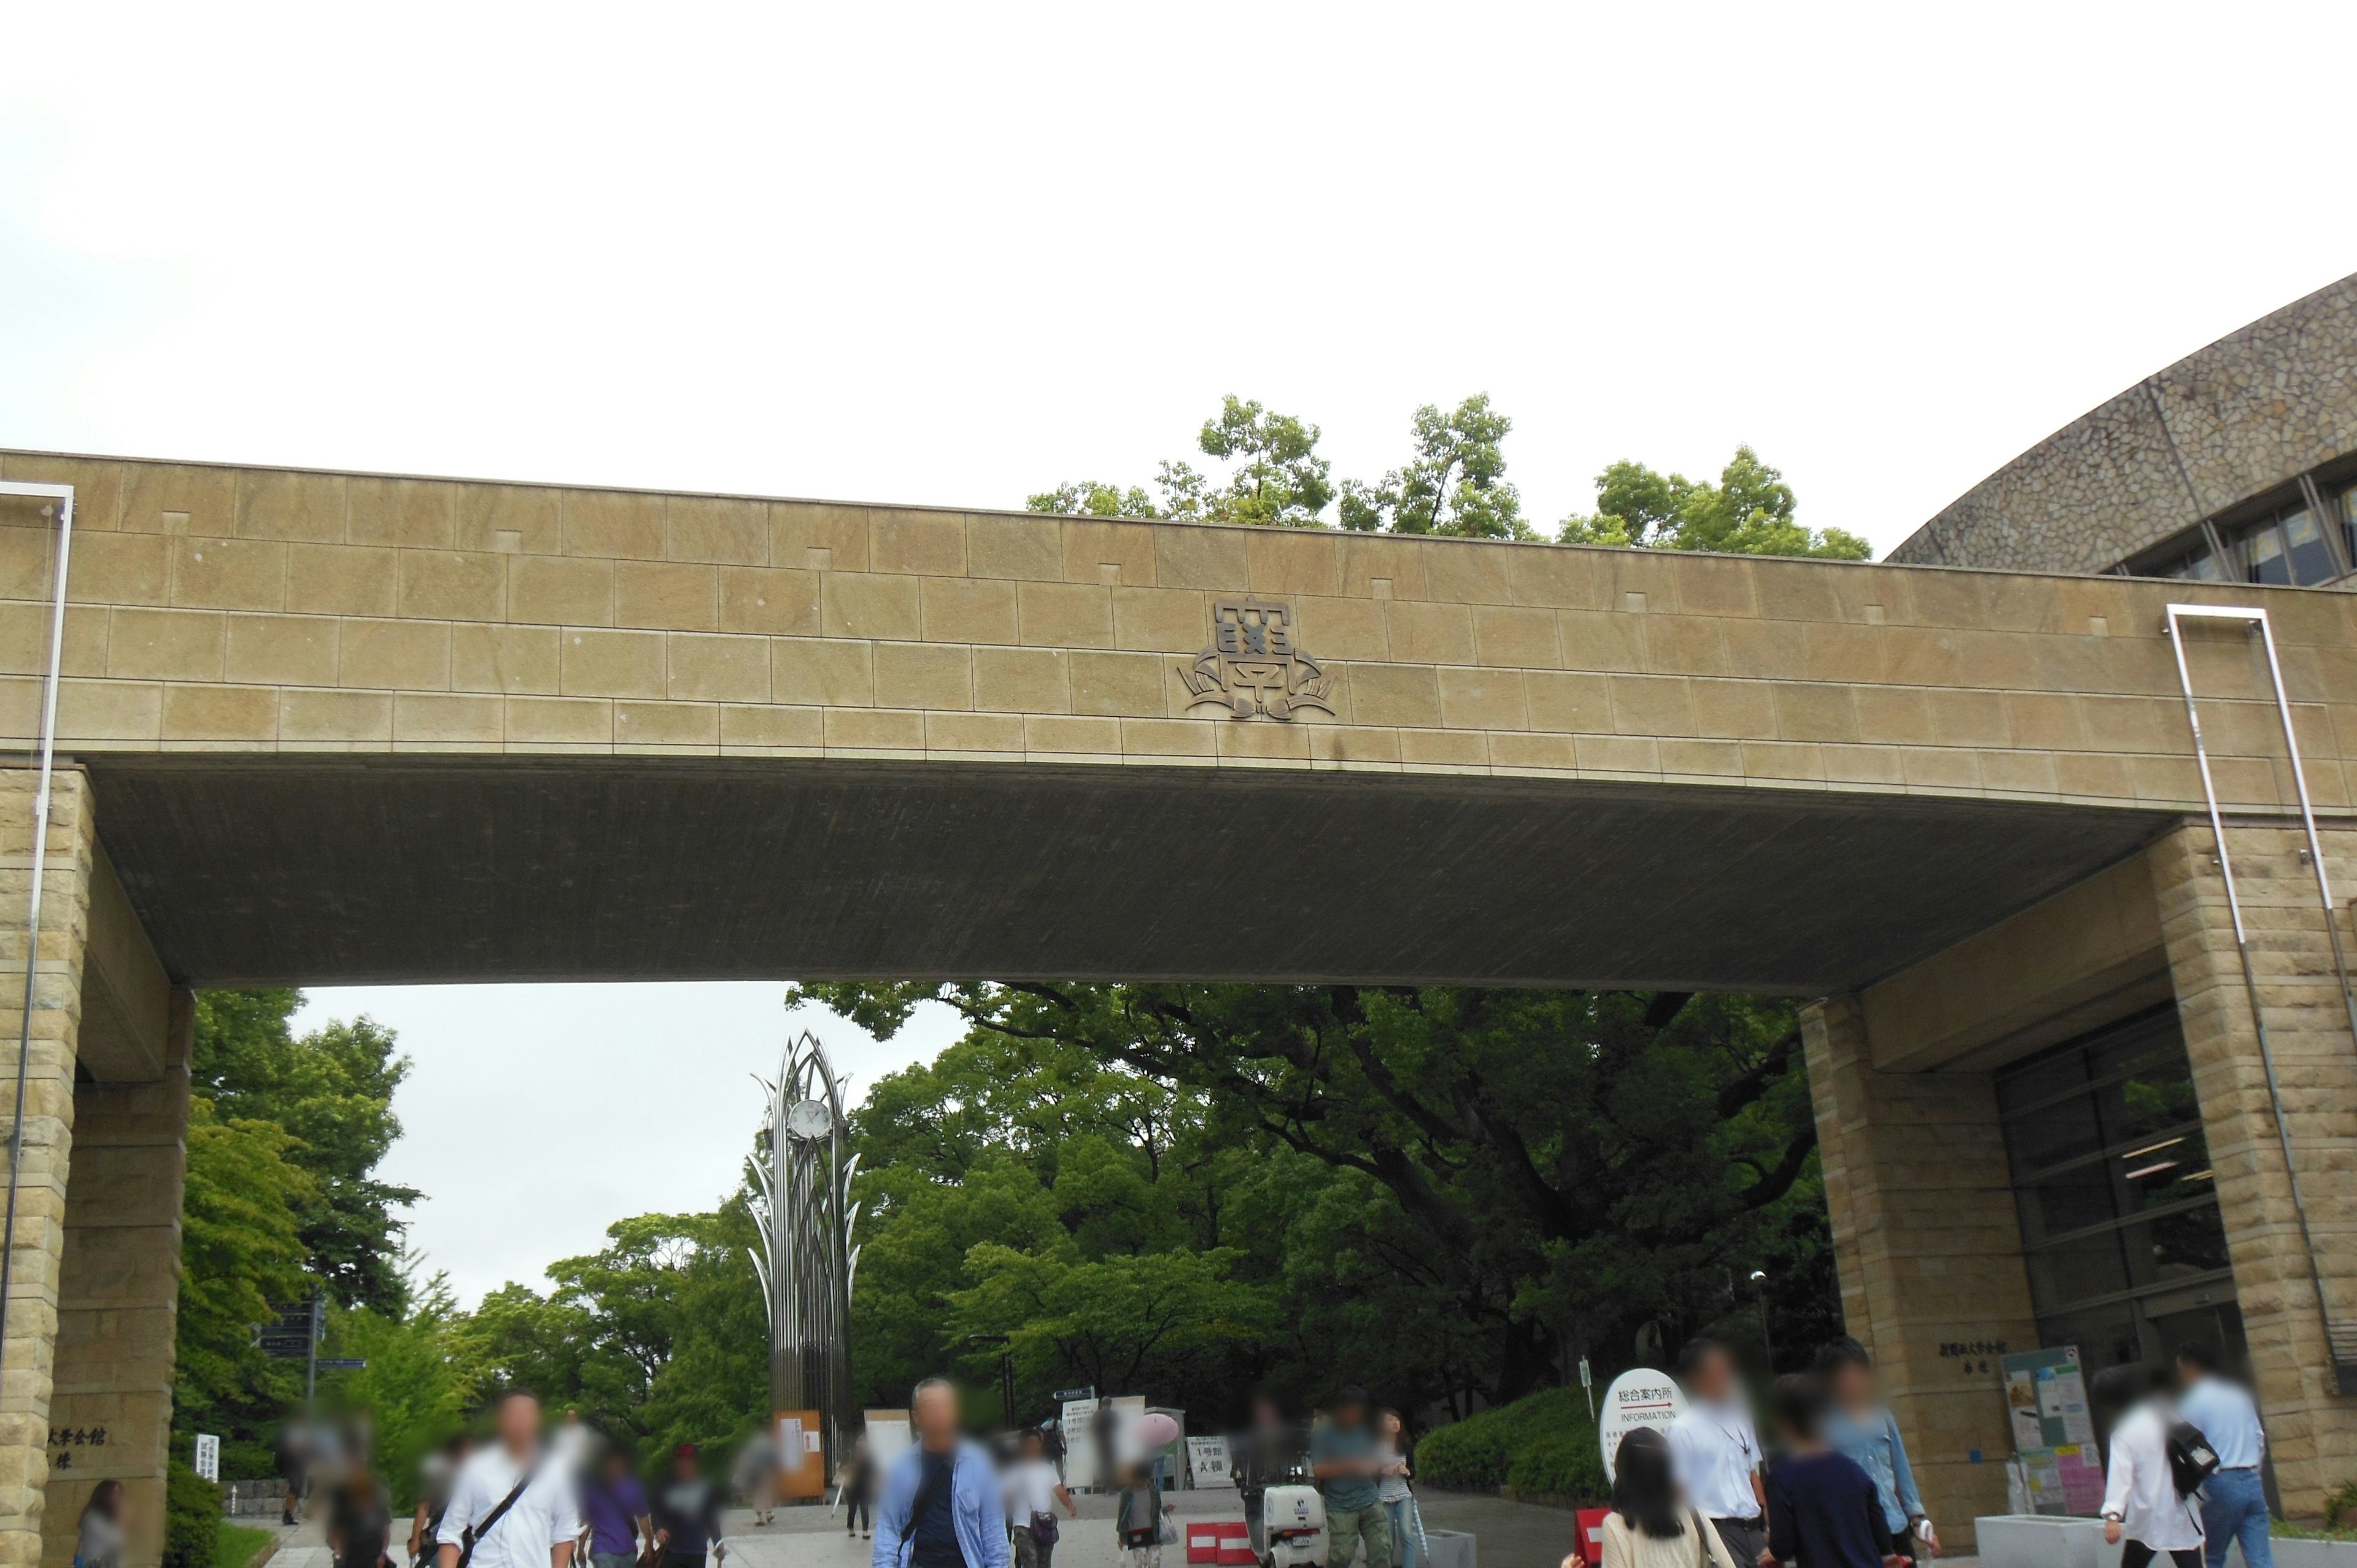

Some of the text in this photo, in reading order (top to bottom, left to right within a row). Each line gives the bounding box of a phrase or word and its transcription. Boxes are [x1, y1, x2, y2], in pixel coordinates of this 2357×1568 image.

[1619, 1387, 1673, 1403] 総合案内所
[1621, 1411, 1676, 1423] INFORMATION
